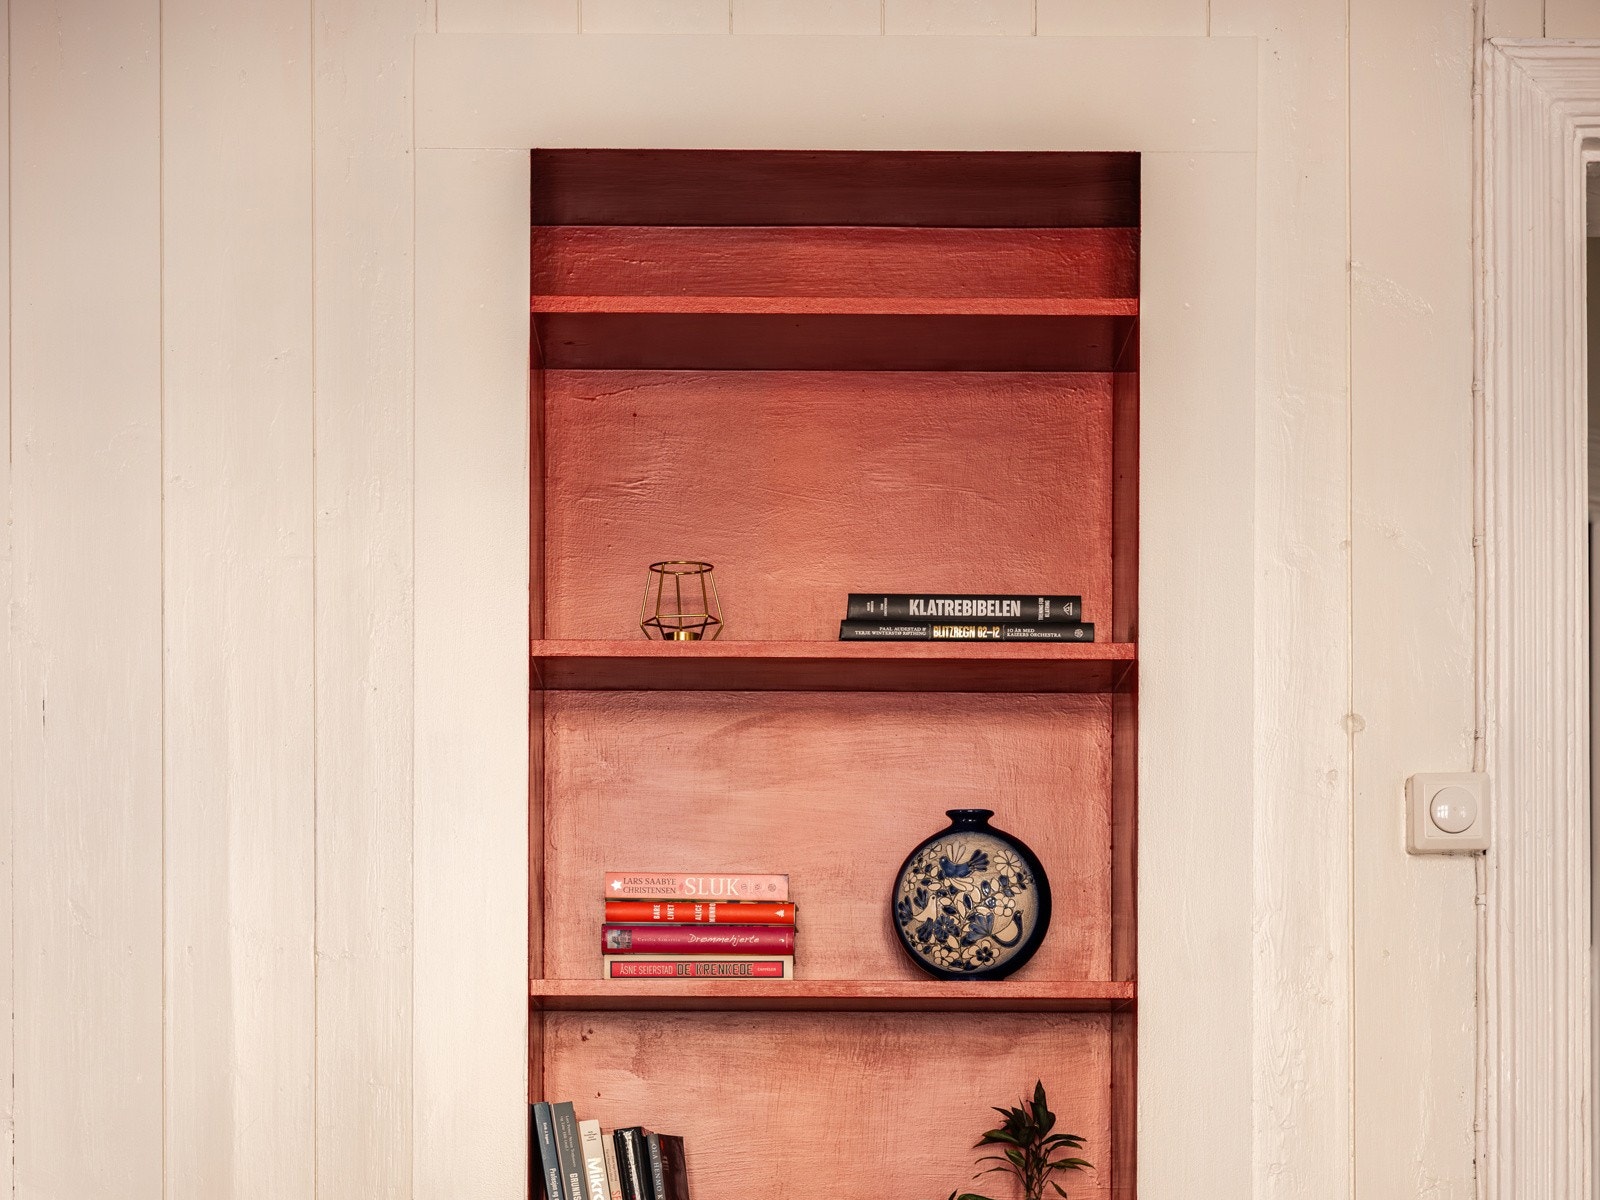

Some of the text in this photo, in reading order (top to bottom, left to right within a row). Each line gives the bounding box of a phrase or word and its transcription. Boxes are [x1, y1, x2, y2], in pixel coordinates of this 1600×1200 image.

[909, 599, 1021, 617] KLATREBIBELEN
[933, 625, 976, 638] BLITZREGN
[623, 877, 676, 886] LARS SAABYE
[684, 877, 741, 896] SLUK
[622, 886, 676, 894] CHRISTENSEN
[687, 933, 760, 947] Drømmehjerte
[620, 962, 637, 975] ÅSNE
[639, 964, 674, 975] SEIERSTAD
[677, 962, 692, 976] DE
[549, 1167, 558, 1191] Profesjon
[653, 1162, 662, 1192] HENMO
